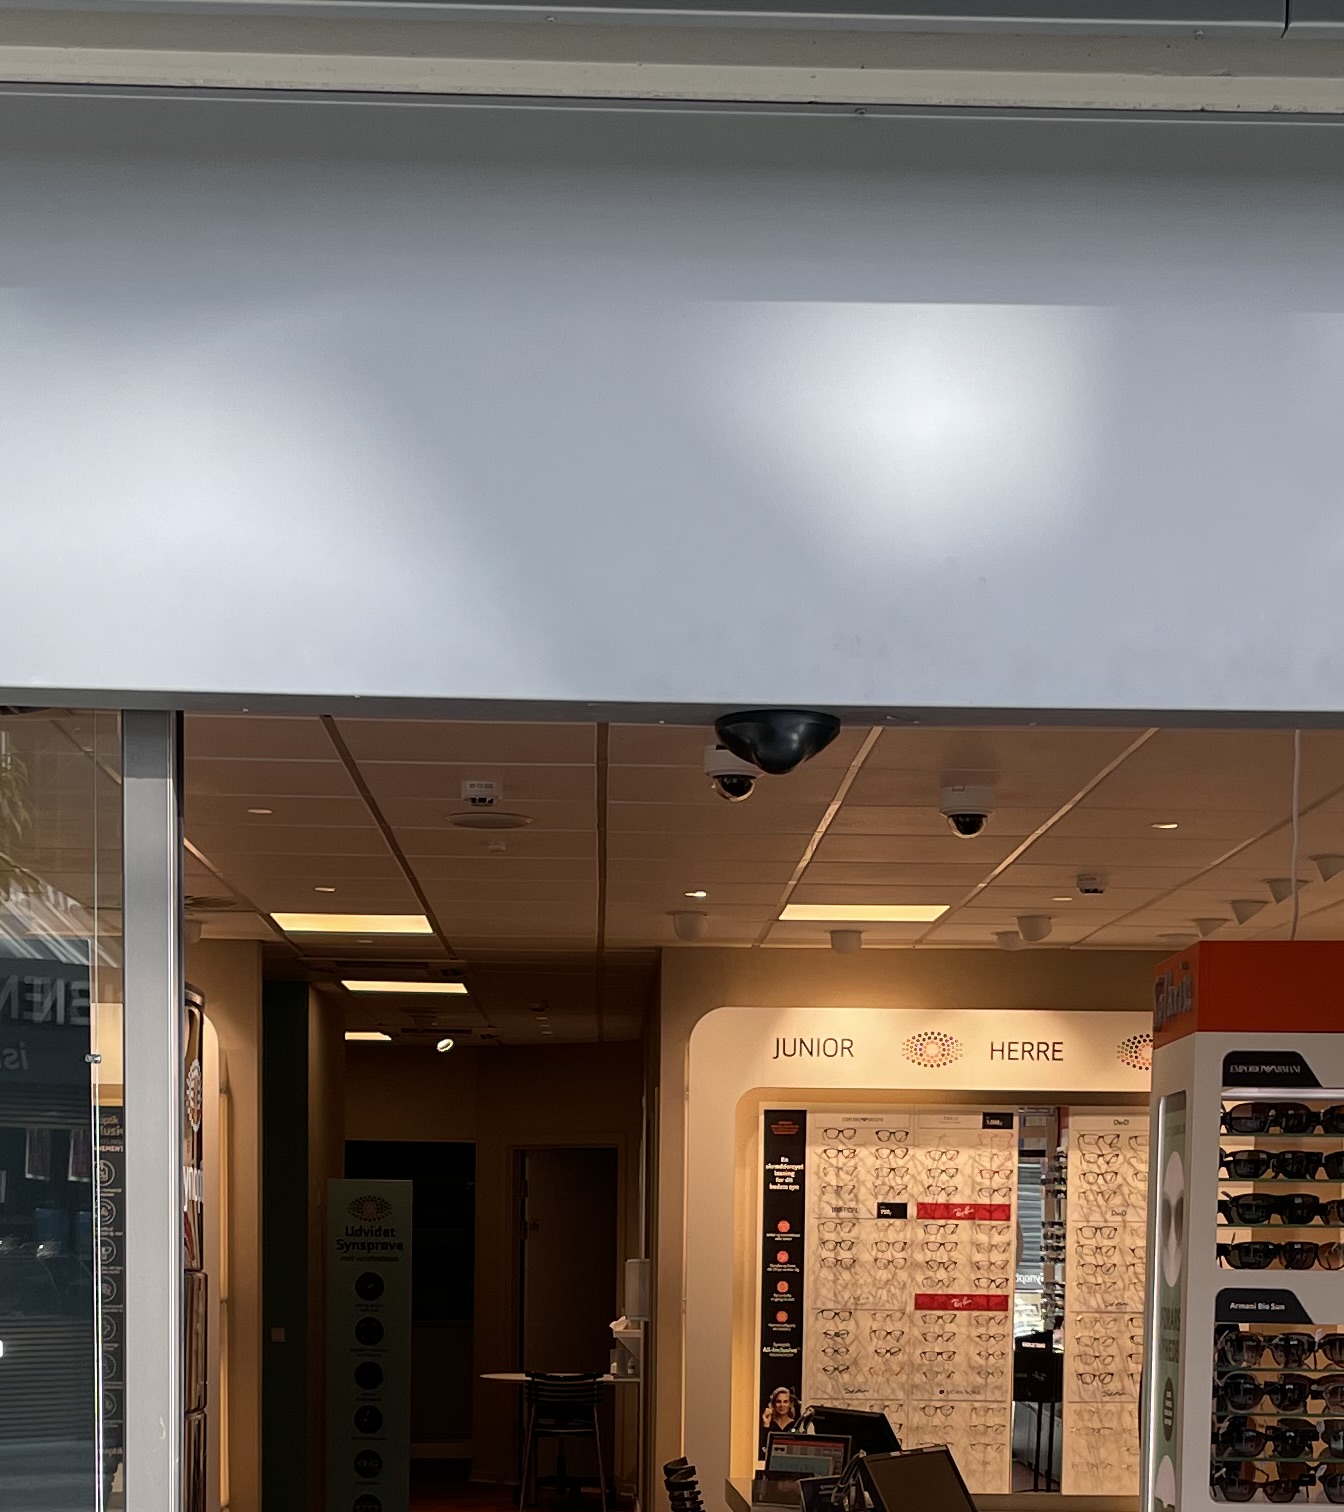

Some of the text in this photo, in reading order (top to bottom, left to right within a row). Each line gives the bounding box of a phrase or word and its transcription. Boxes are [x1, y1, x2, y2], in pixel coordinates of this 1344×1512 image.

[772, 1037, 1064, 1061] JUNIOR HERRE
[345, 1226, 396, 1238] Udvidet
